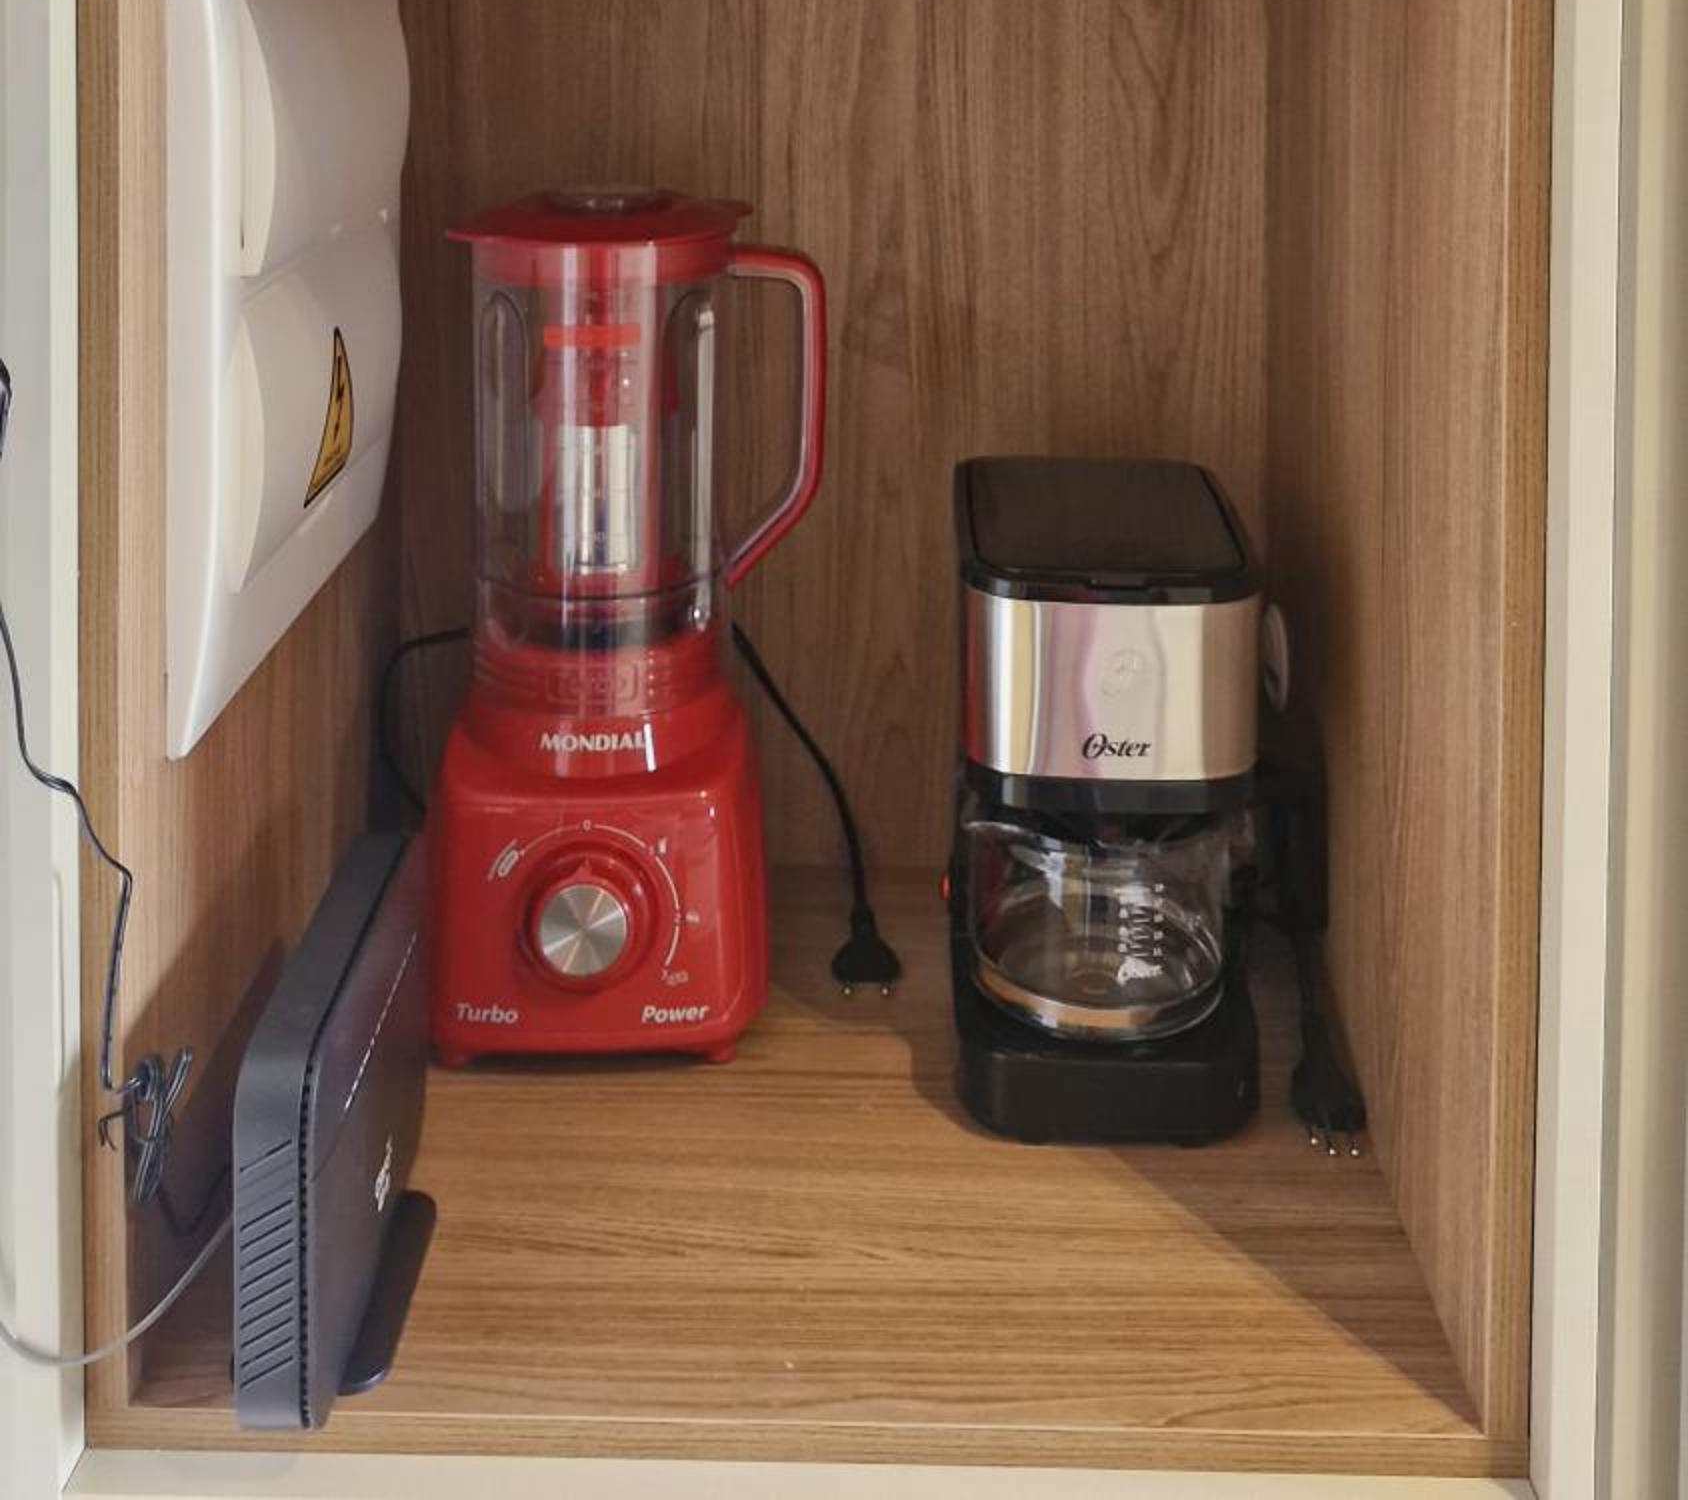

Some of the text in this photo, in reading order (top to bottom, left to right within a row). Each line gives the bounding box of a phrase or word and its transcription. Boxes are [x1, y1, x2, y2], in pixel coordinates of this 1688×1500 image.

[541, 730, 647, 752] MONDIAL
[1081, 733, 1152, 759] Oster
[456, 1003, 519, 1024] Turbo
[641, 1005, 710, 1024] Power
